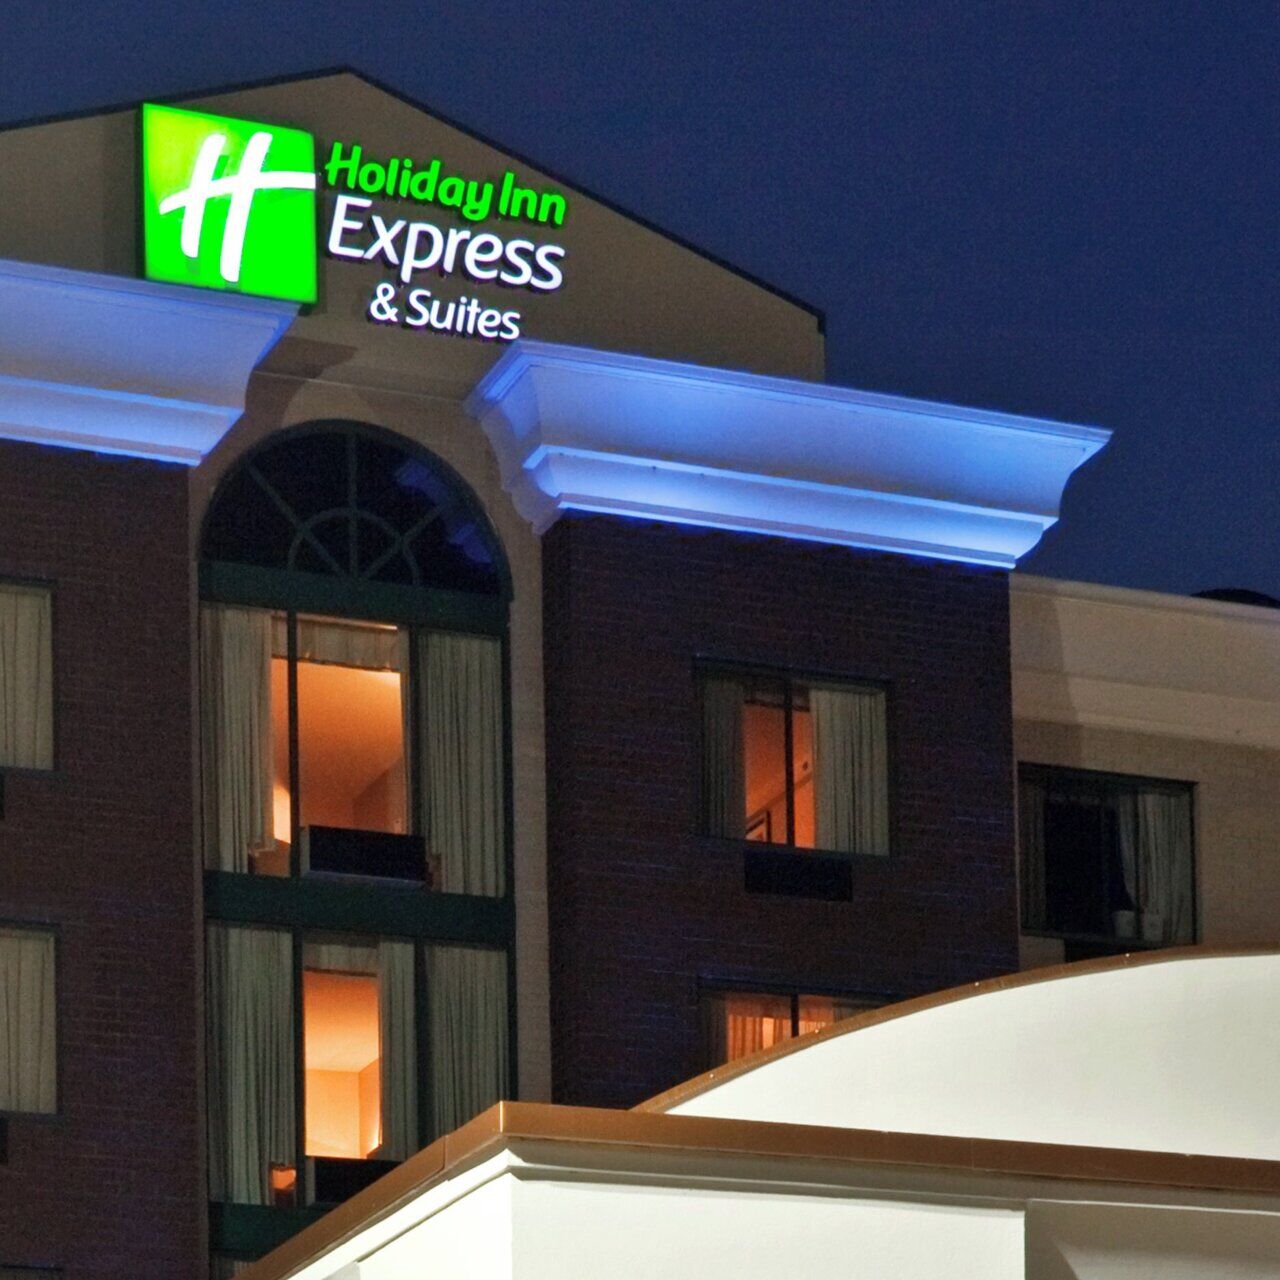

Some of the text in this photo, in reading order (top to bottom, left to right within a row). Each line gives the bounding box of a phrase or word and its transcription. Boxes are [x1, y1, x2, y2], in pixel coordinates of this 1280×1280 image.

[325, 142, 566, 225] Holiday Inn
[328, 194, 566, 291] Express
[369, 282, 521, 341] & Suites
